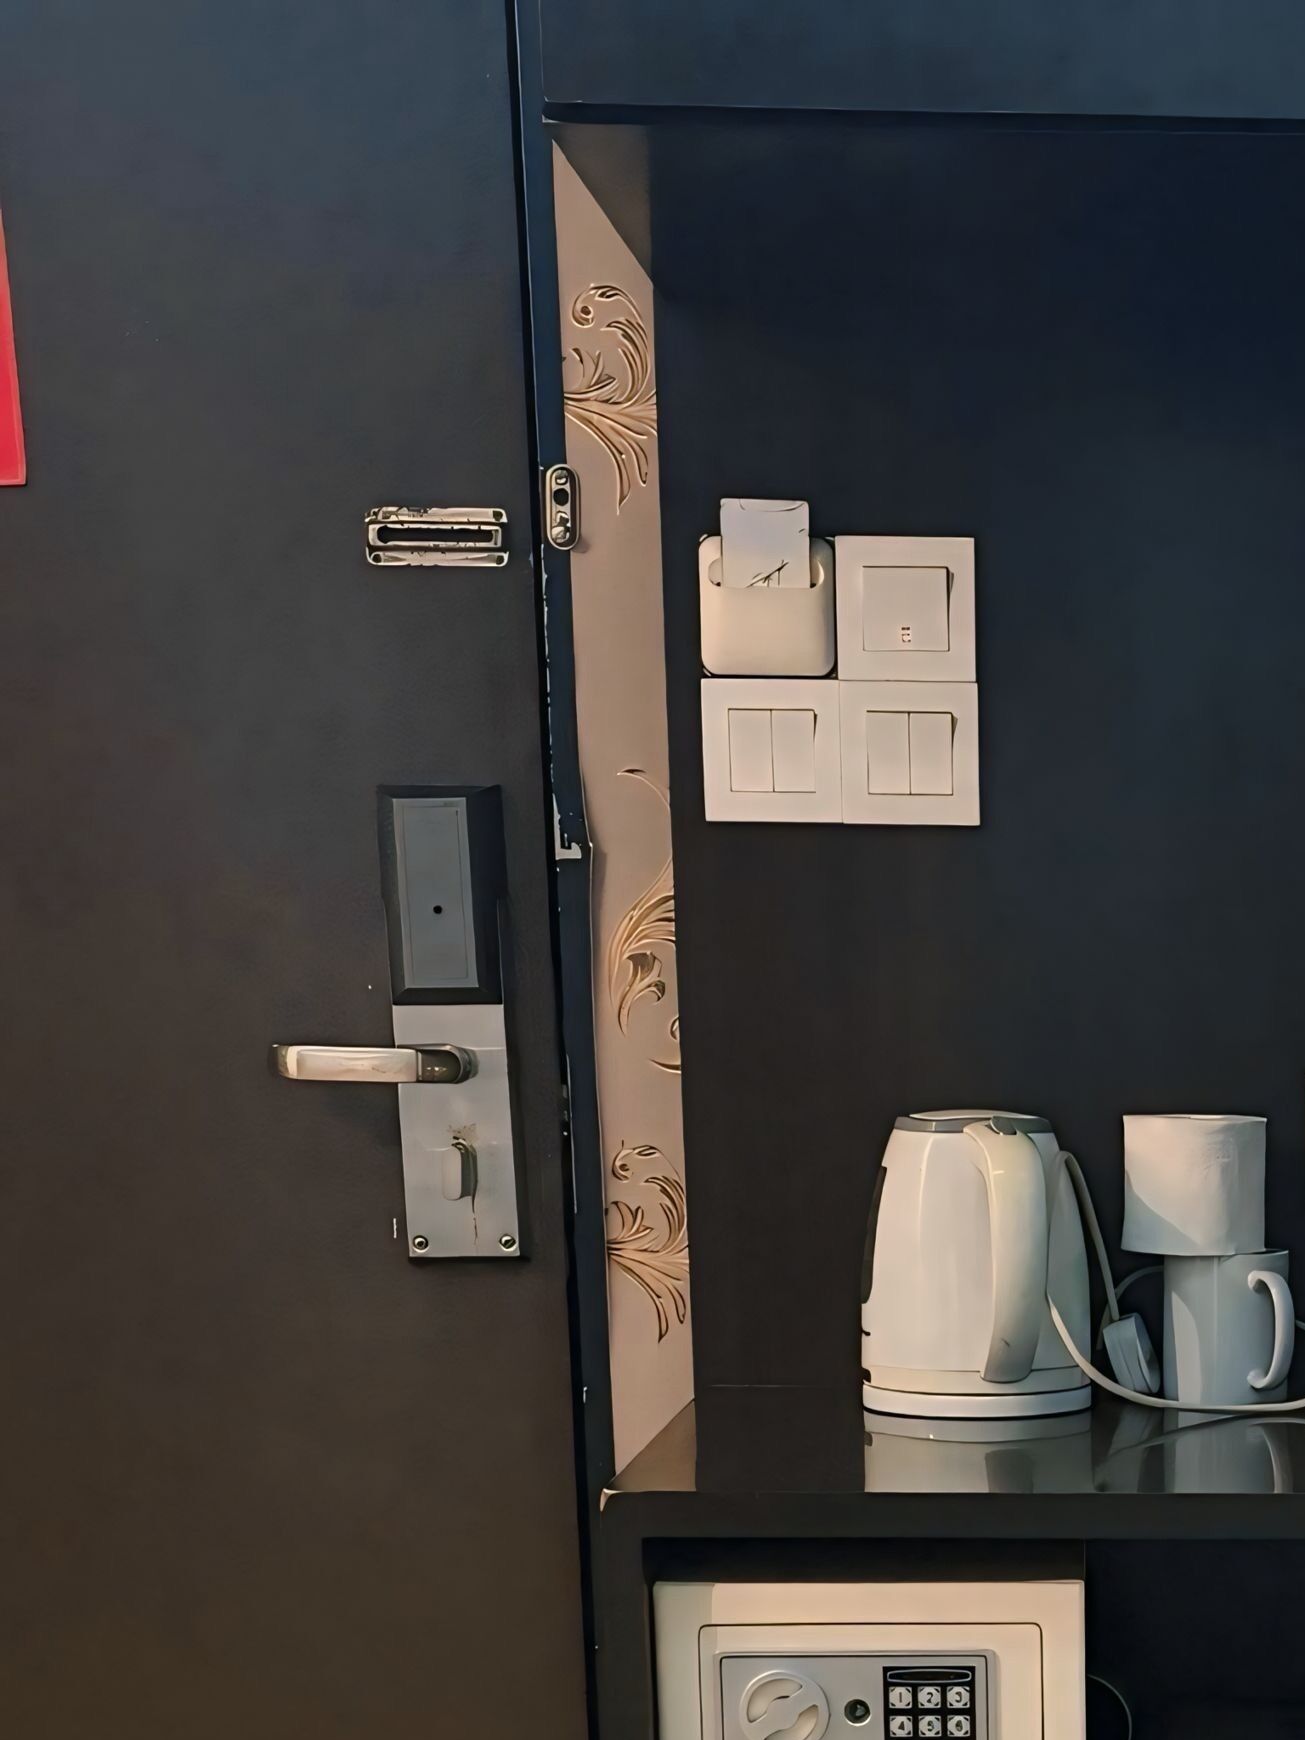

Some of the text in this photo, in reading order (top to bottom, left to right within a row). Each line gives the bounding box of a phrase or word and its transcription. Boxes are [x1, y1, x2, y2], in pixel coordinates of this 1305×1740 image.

[926, 1691, 934, 1704] 2
[954, 1691, 963, 1704] 3
[926, 1720, 935, 1732] 5
